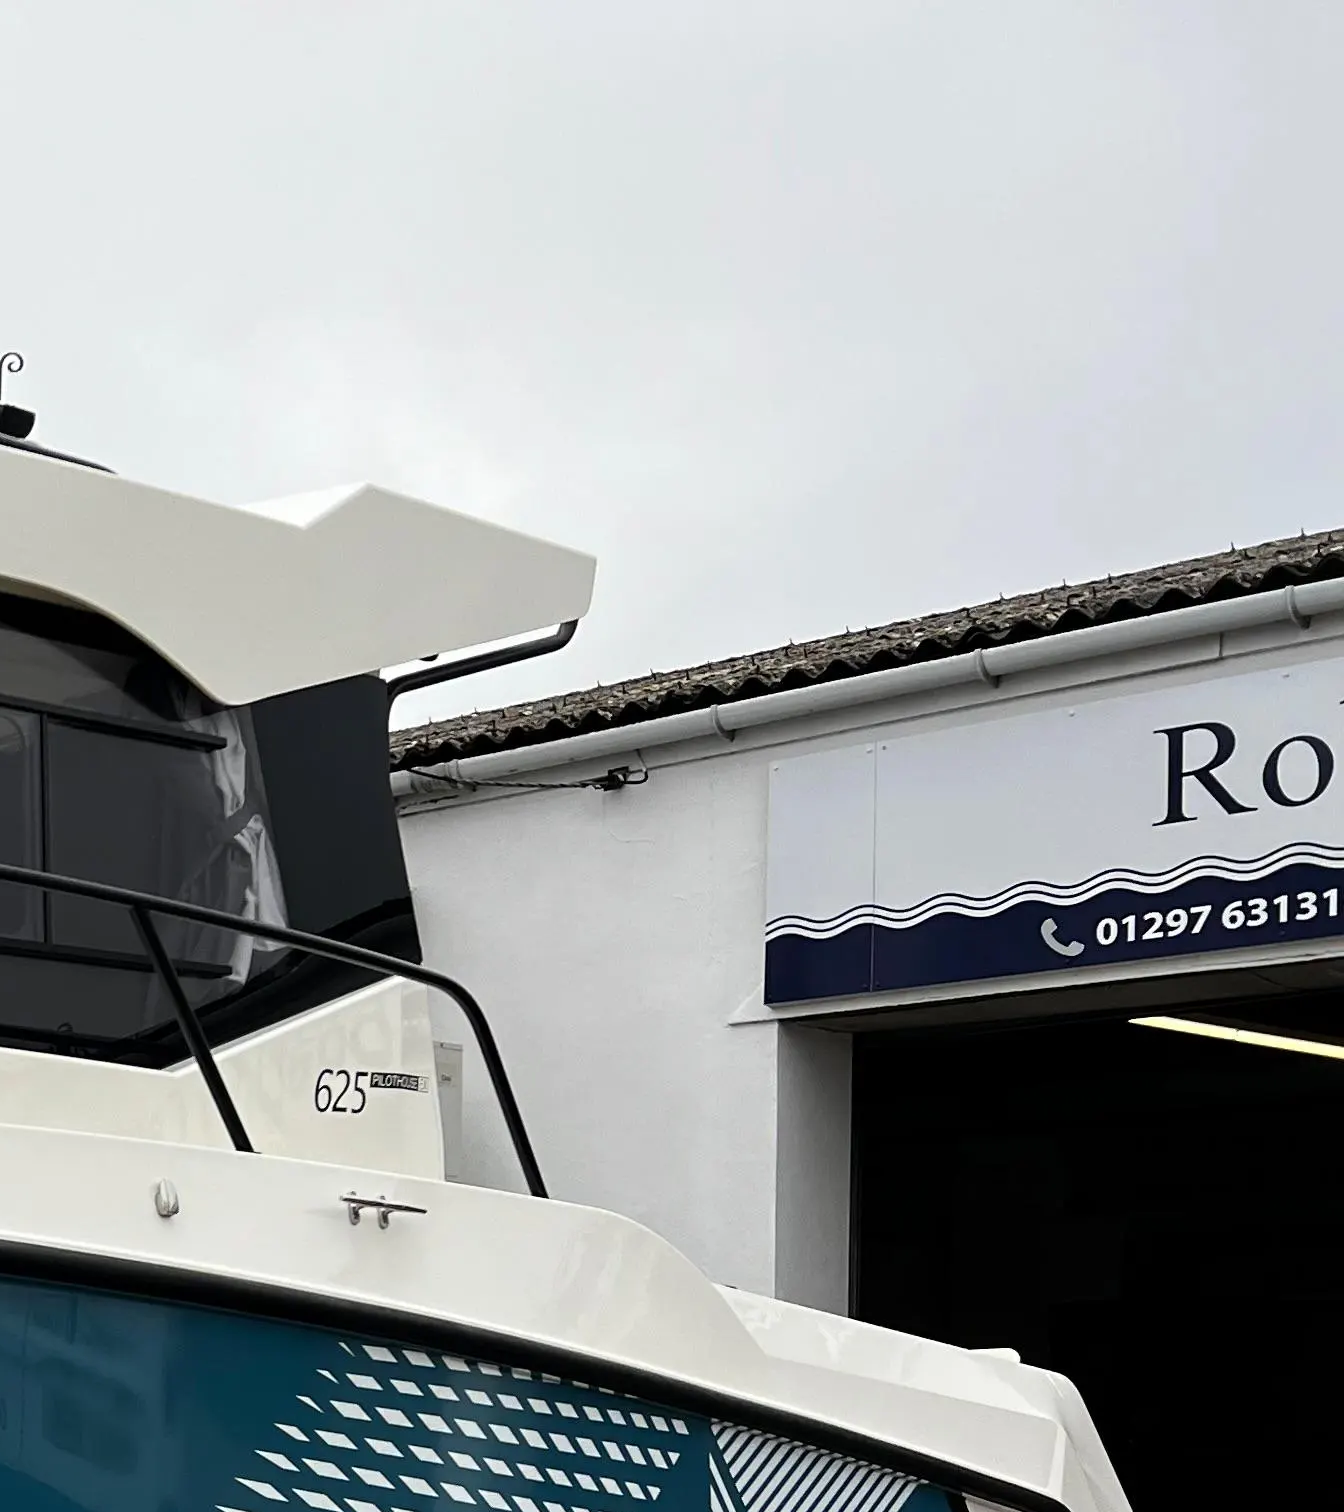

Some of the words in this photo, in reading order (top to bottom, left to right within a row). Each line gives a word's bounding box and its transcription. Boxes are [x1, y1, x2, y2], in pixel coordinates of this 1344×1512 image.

[1152, 702, 1344, 827] Ro
[1096, 904, 1211, 946] 01297
[314, 1069, 368, 1113] 625
